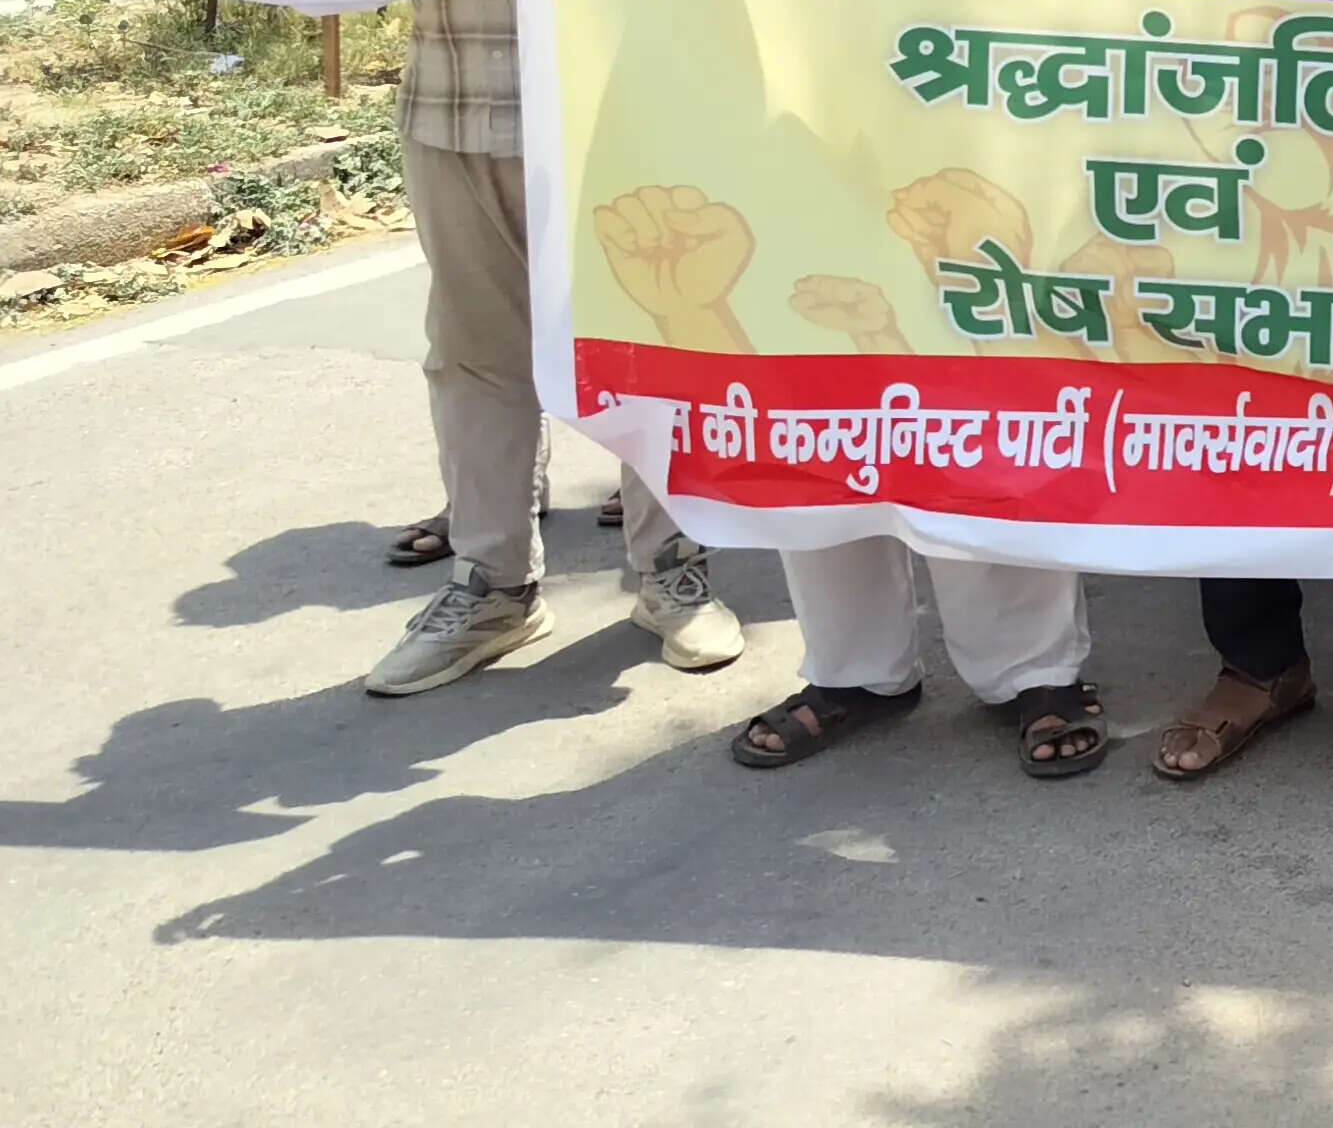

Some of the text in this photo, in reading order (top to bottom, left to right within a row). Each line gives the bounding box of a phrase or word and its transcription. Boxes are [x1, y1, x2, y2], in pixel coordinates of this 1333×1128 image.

[1086, 140, 1264, 241] एवं
[937, 239, 1112, 342] रोष
[701, 383, 757, 461] की
[768, 384, 990, 494] कम्युनिस्ट
[997, 387, 1091, 469] पार्टी
